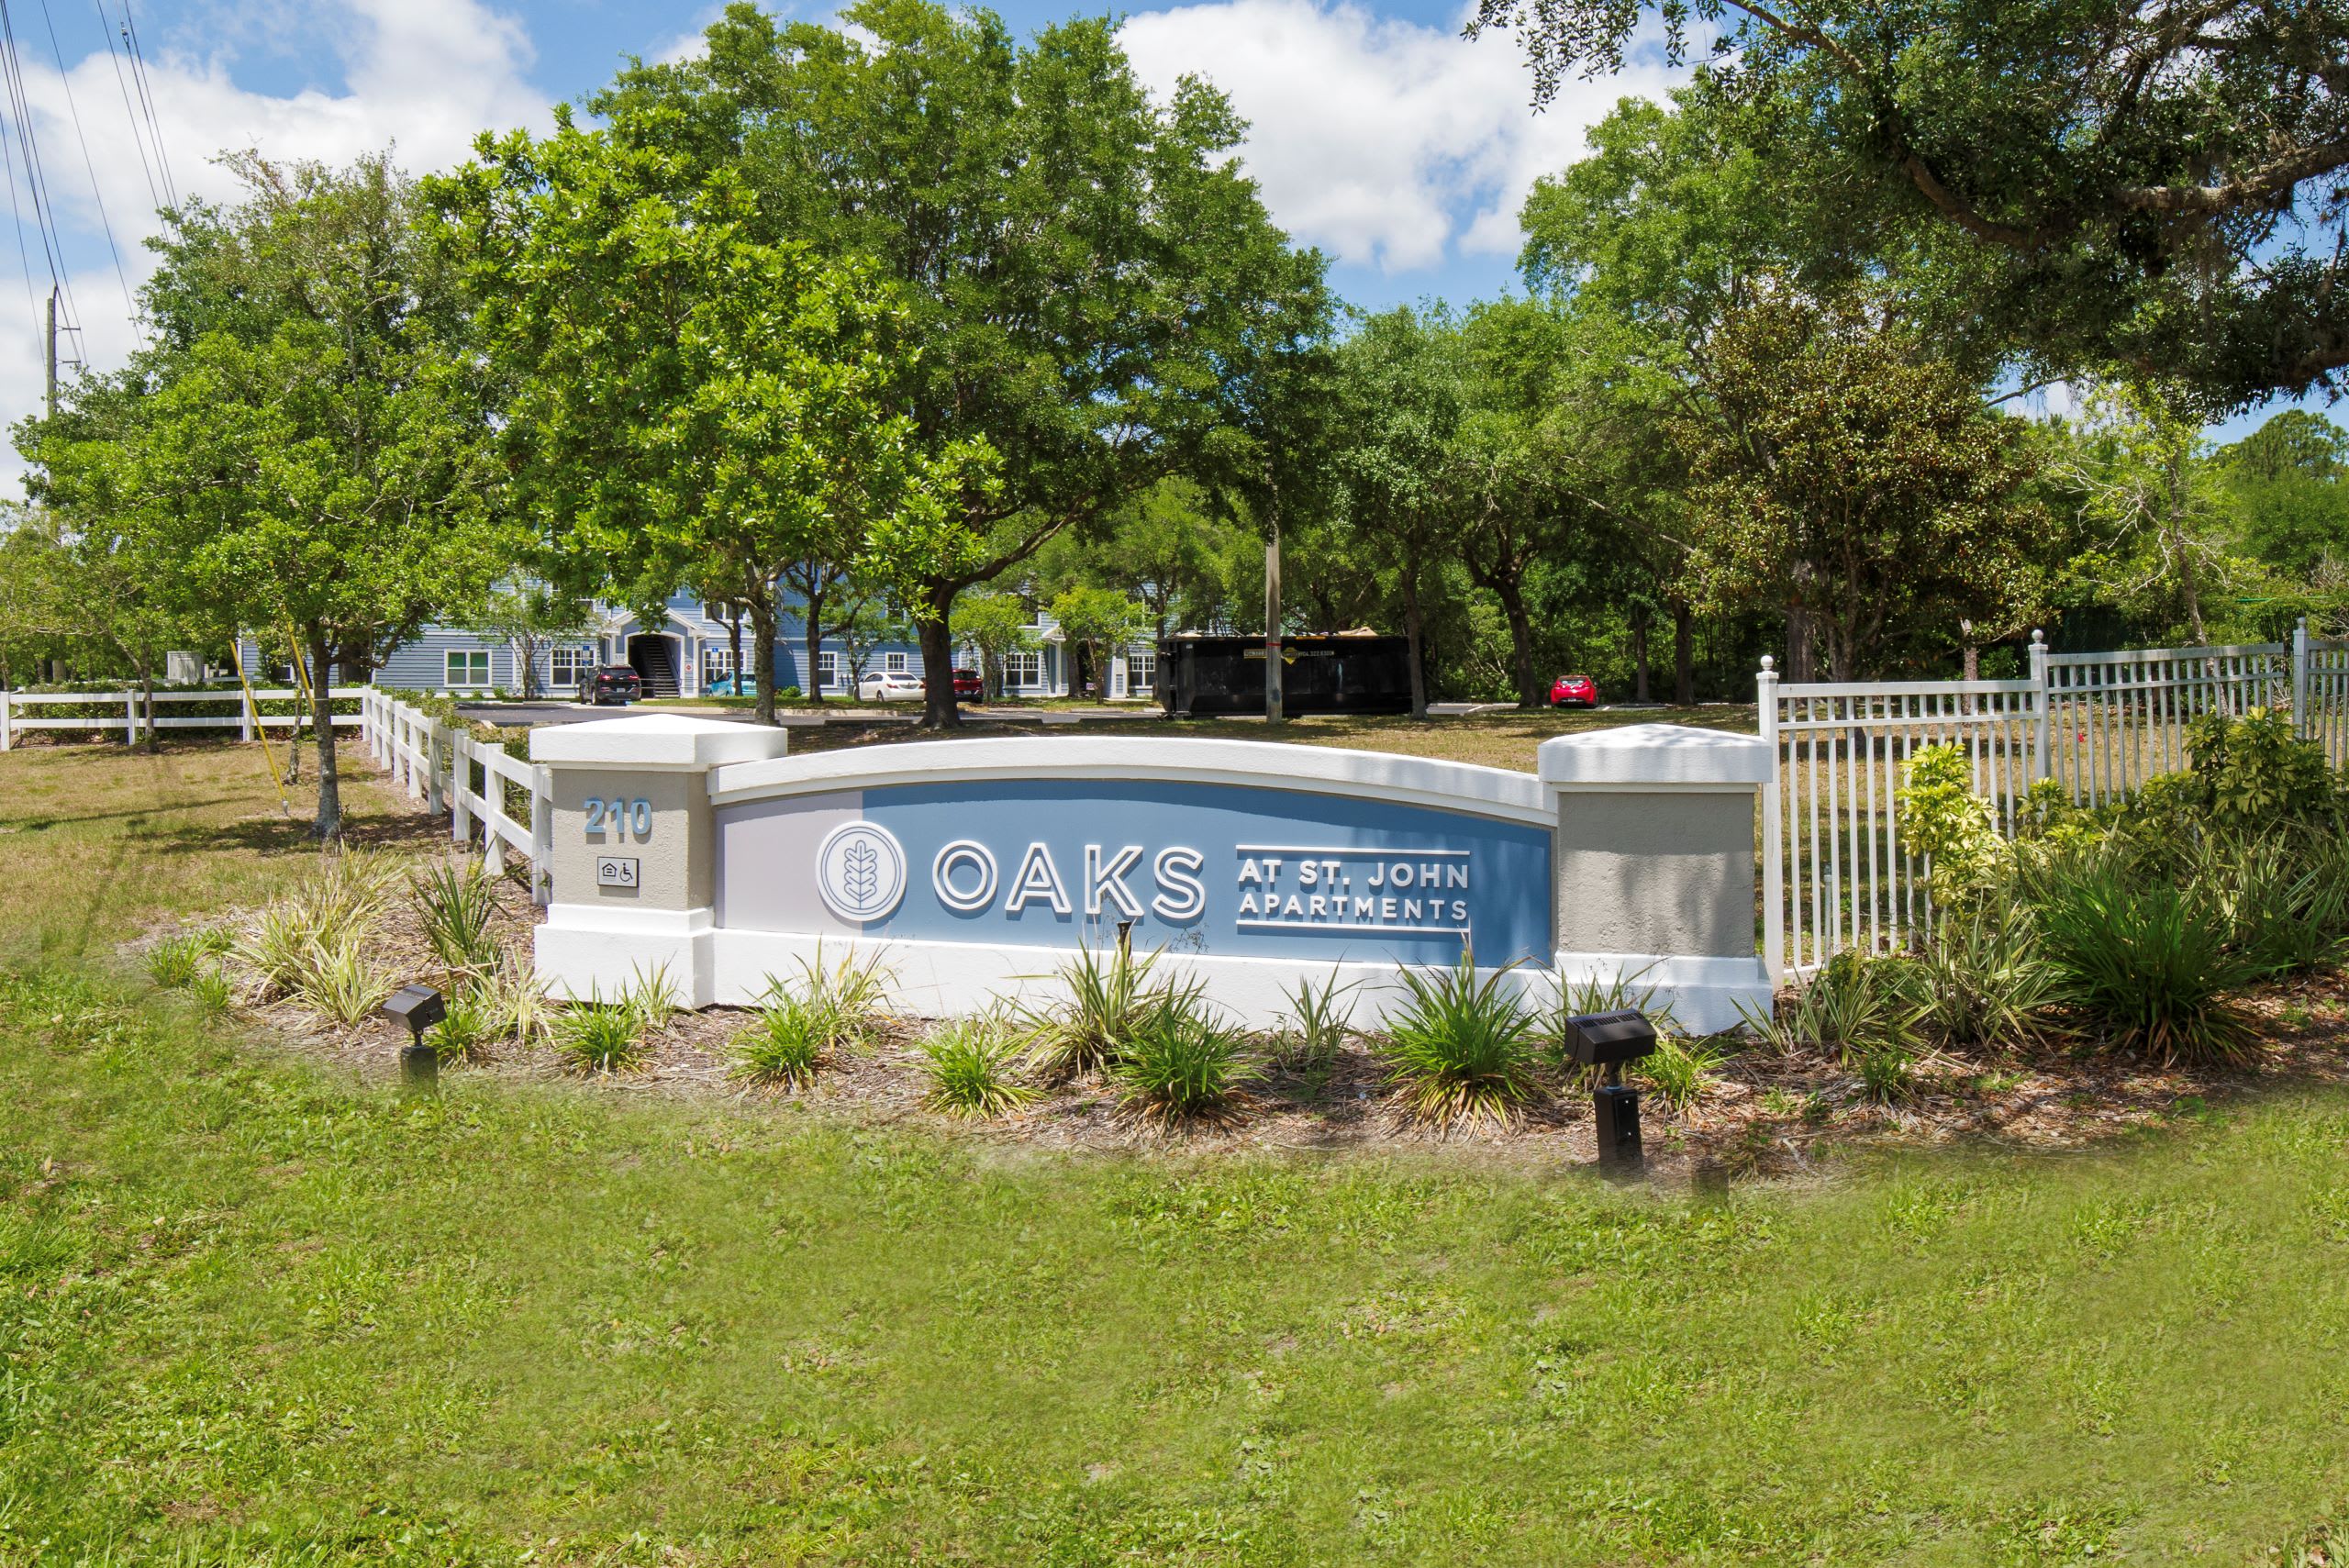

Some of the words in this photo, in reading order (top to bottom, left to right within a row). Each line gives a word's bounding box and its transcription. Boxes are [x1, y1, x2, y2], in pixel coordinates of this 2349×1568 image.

[584, 796, 652, 835] 210
[932, 840, 1206, 919] OAKS
[1238, 859, 1282, 883] AT
[1298, 860, 1351, 885] ST.
[1367, 862, 1468, 888] JOHN
[1239, 893, 1467, 920] APARTMENTS
